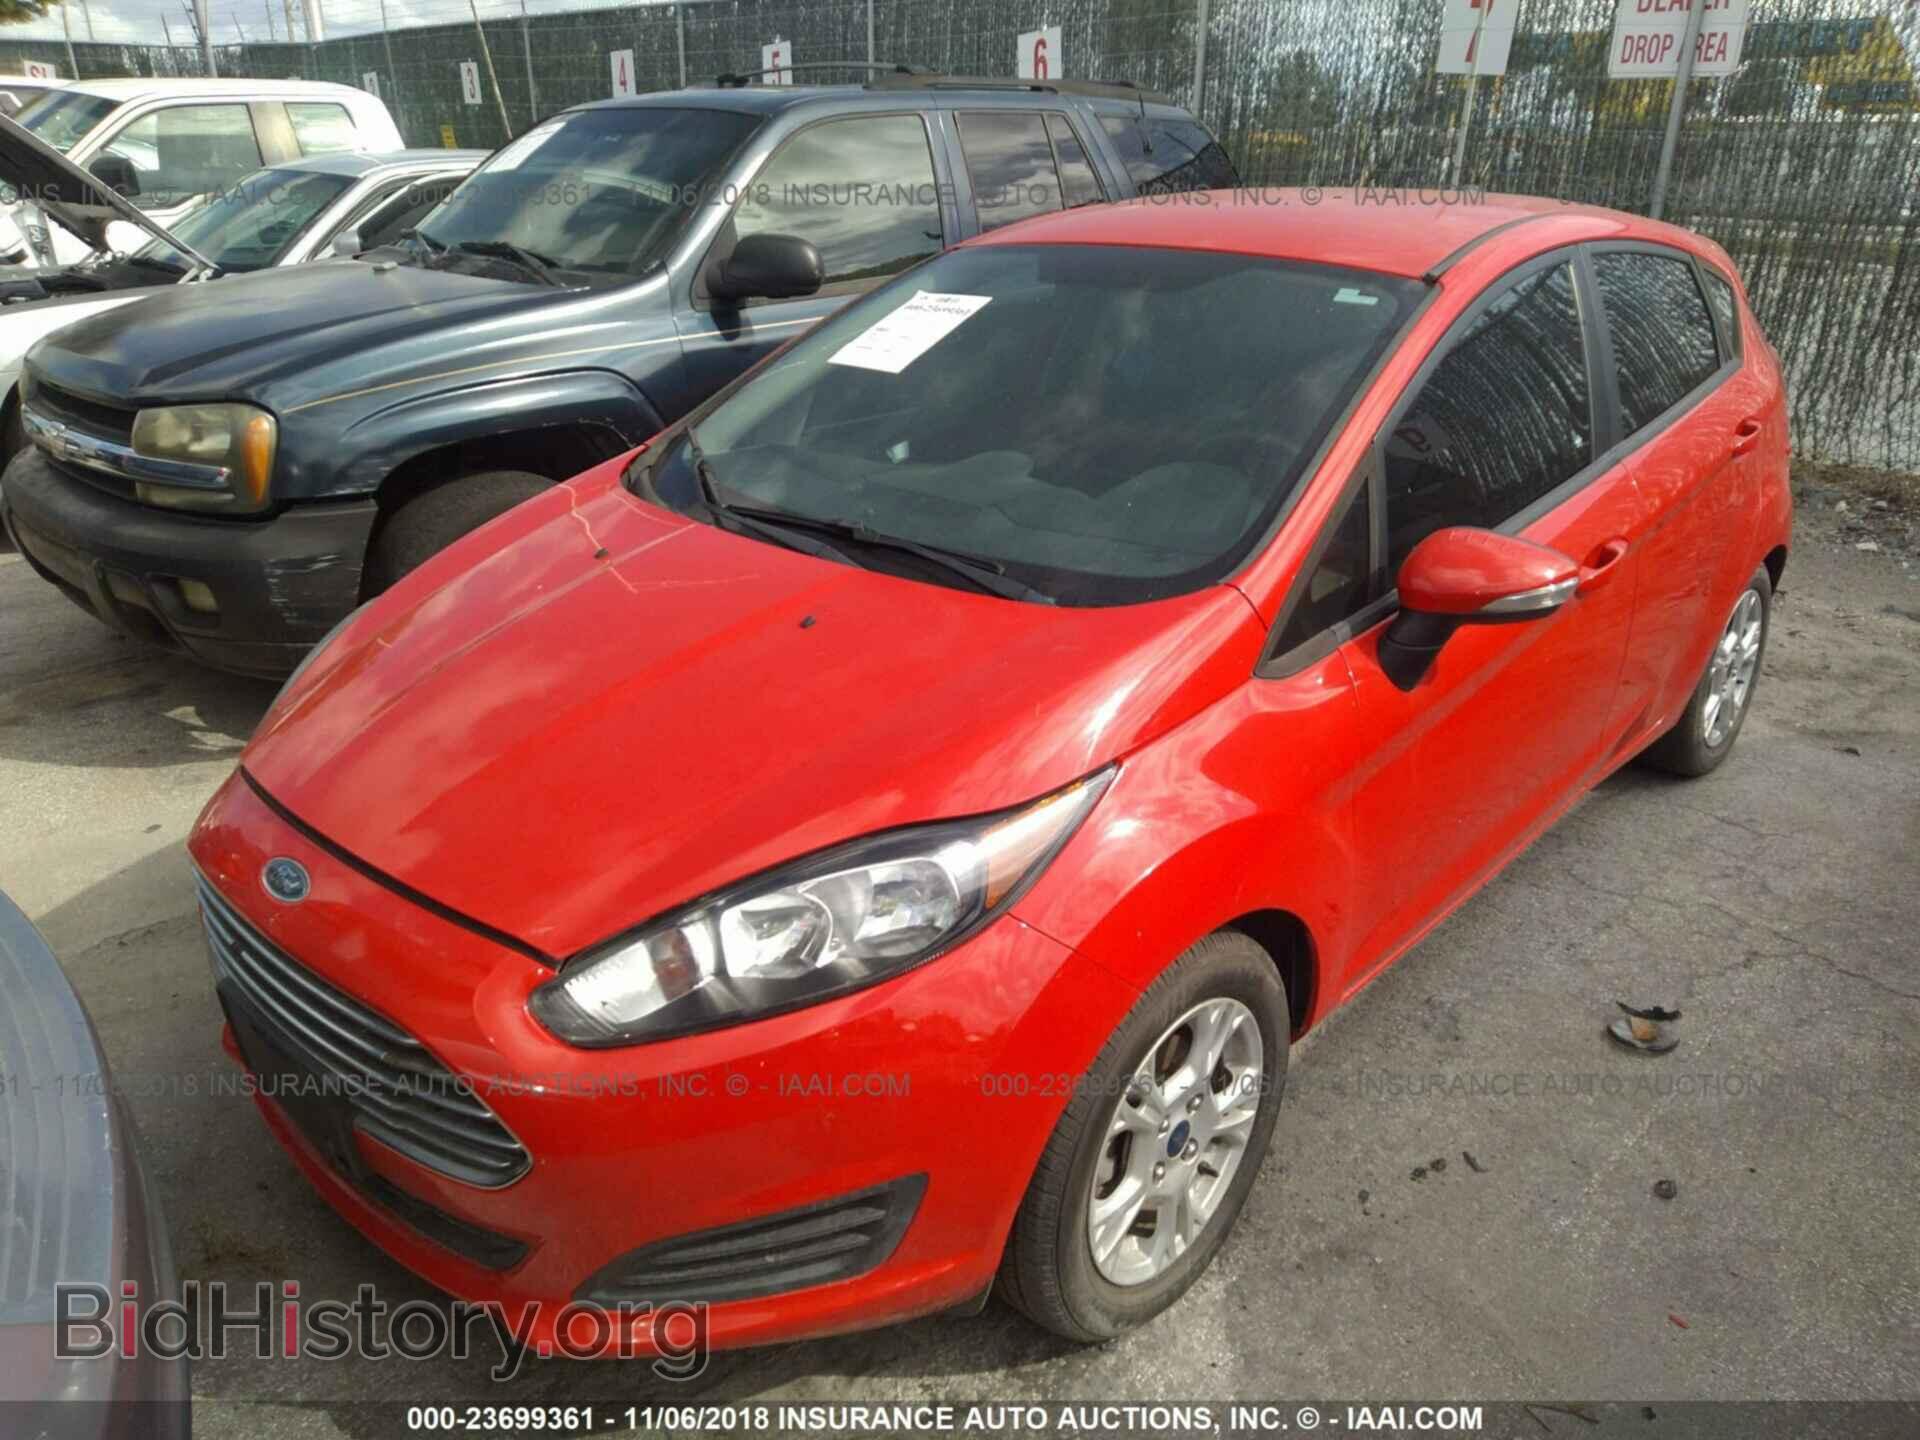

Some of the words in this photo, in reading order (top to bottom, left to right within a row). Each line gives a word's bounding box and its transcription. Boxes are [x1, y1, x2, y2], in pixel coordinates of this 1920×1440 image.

[1034, 38, 1048, 80] 6
[1620, 33, 1674, 64] DROP
[1676, 31, 1729, 63] REA
[465, 67, 477, 99] 3
[618, 57, 628, 93] 4
